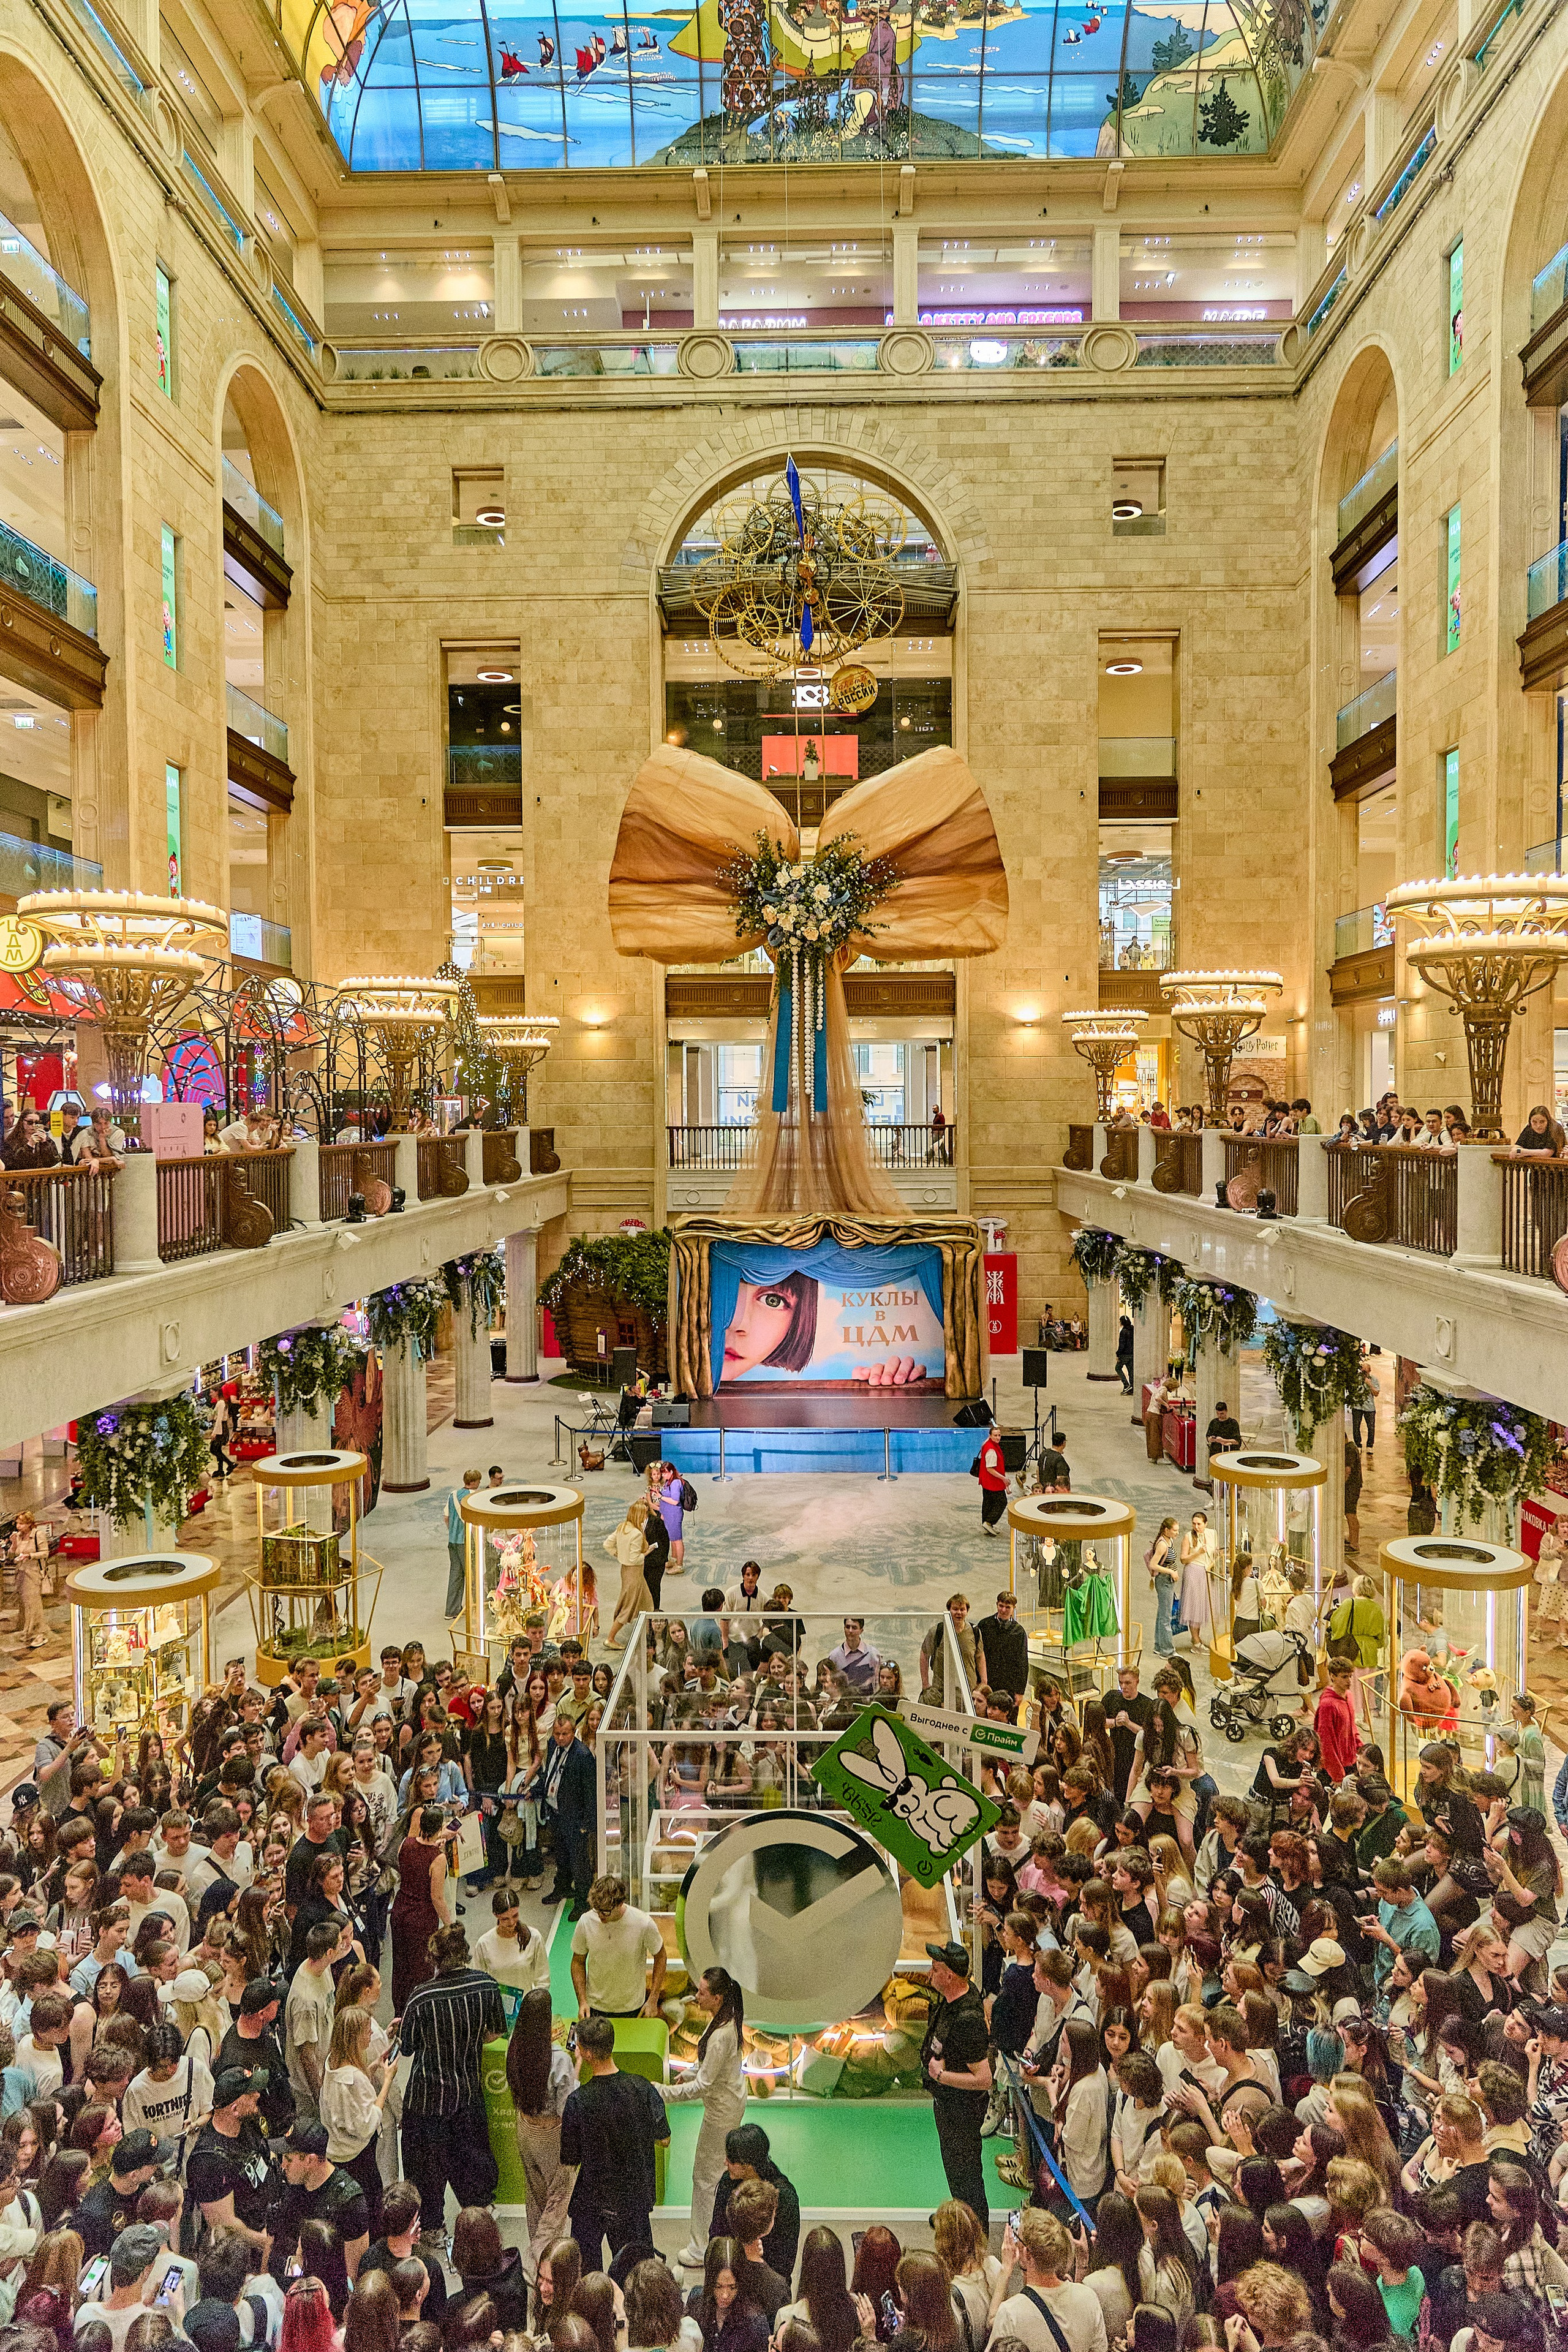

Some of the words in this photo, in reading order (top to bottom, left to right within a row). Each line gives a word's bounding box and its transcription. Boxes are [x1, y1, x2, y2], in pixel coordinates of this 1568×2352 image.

[933, 313, 984, 325] KITTY
[1017, 312, 1082, 324] FRIENDS
[838, 684, 876, 706] РОССИИ
[1257, 1038, 1279, 1055] Potter
[842, 1291, 919, 1307] КУКЛЫ
[842, 1325, 920, 1348] ЦДМ
[910, 1713, 960, 1733] Выгоднее
[961, 1727, 968, 1735] с
[987, 1732, 1018, 1747] Прайм
